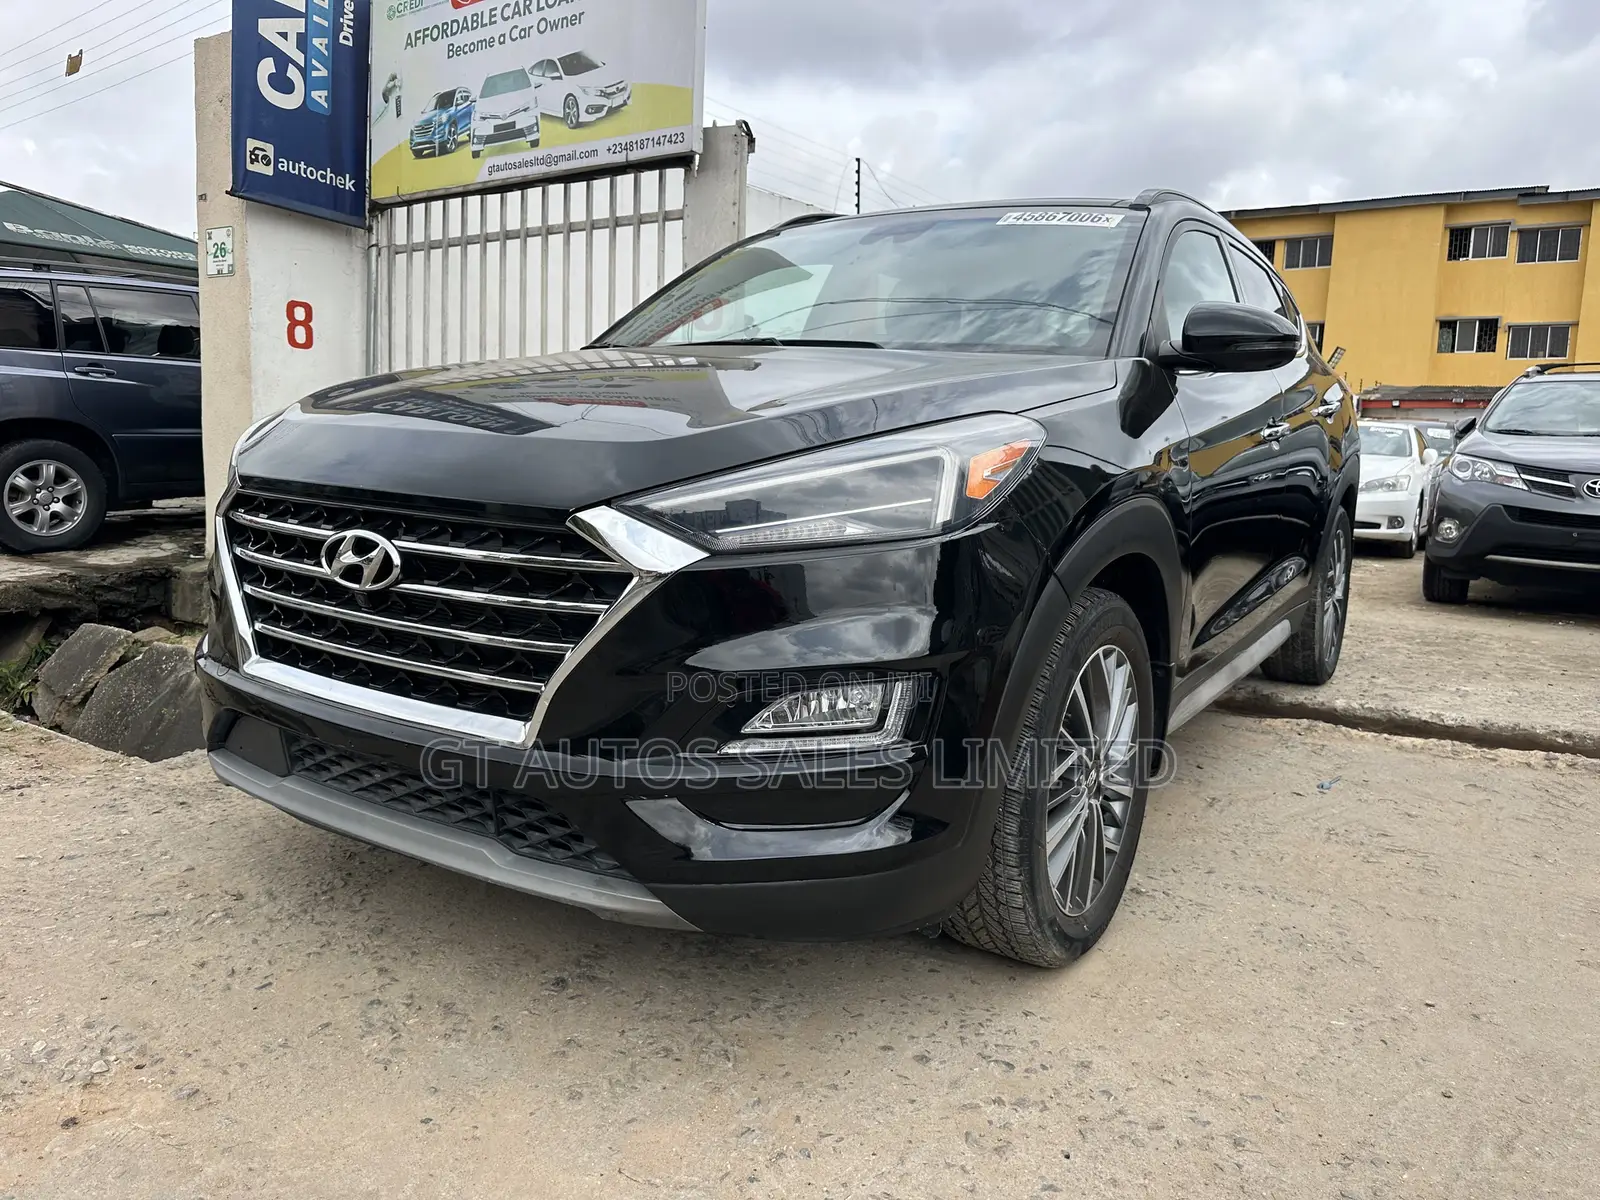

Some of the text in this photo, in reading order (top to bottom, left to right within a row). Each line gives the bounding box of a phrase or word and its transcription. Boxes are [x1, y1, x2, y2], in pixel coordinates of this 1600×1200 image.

[404, 7, 498, 50] AFFORDABLE
[500, 0, 533, 22] CAR
[447, 11, 585, 59] Become a Car Owner
[257, 0, 305, 109] CA
[278, 158, 356, 192] autochek
[487, 132, 685, 175] gtautosalesltd@gmail.com +2348187147423
[213, 242, 227, 259] 26
[286, 300, 314, 350] 8
